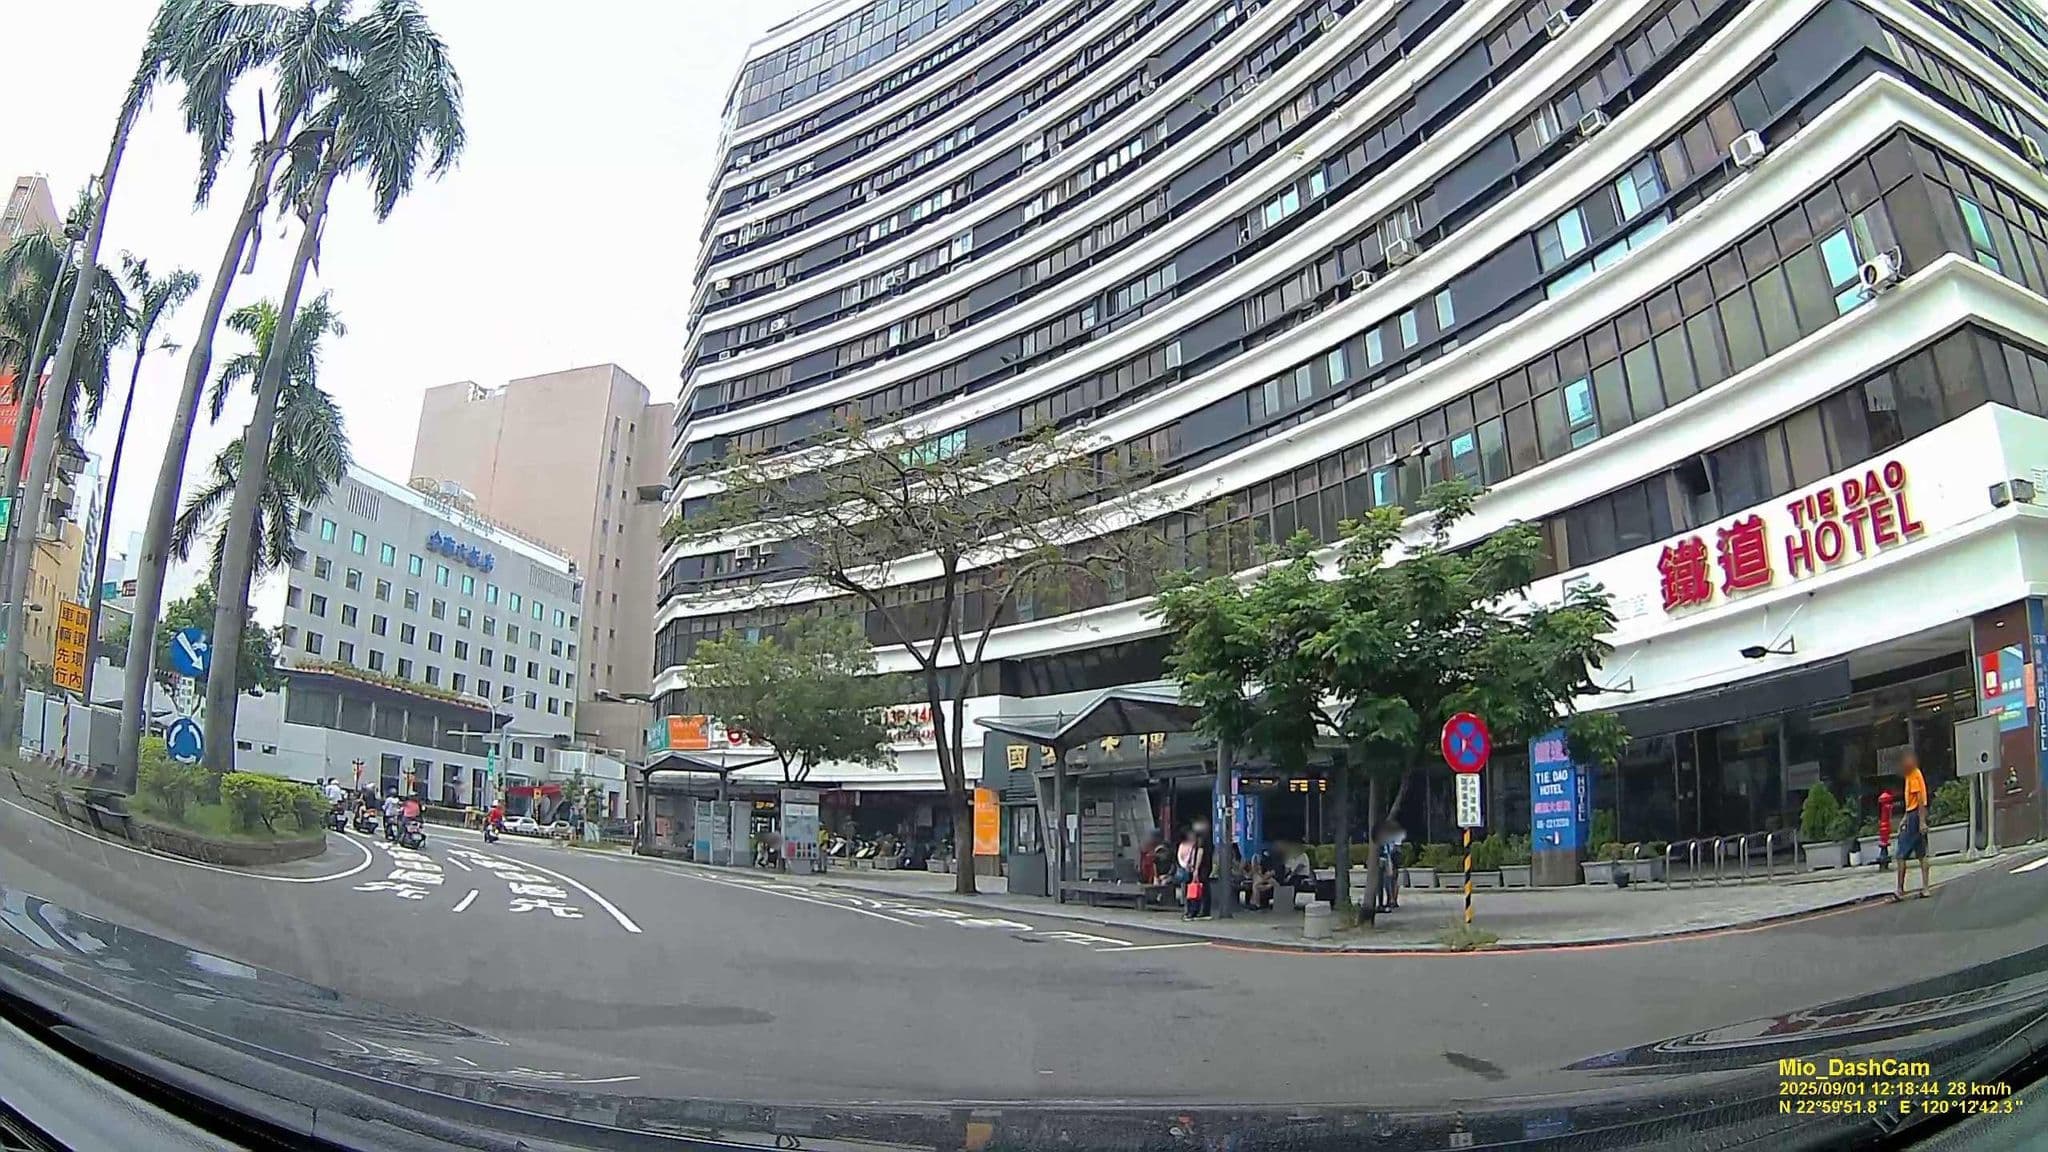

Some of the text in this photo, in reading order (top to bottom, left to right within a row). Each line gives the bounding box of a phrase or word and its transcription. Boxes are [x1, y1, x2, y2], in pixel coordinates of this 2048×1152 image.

[1787, 461, 1906, 529] TIE DAO
[1658, 515, 1773, 611] 鐵道
[1785, 493, 1924, 577] HOTEL
[1539, 783, 1564, 796] HOTEL
[1577, 776, 1586, 822] HOTEL
